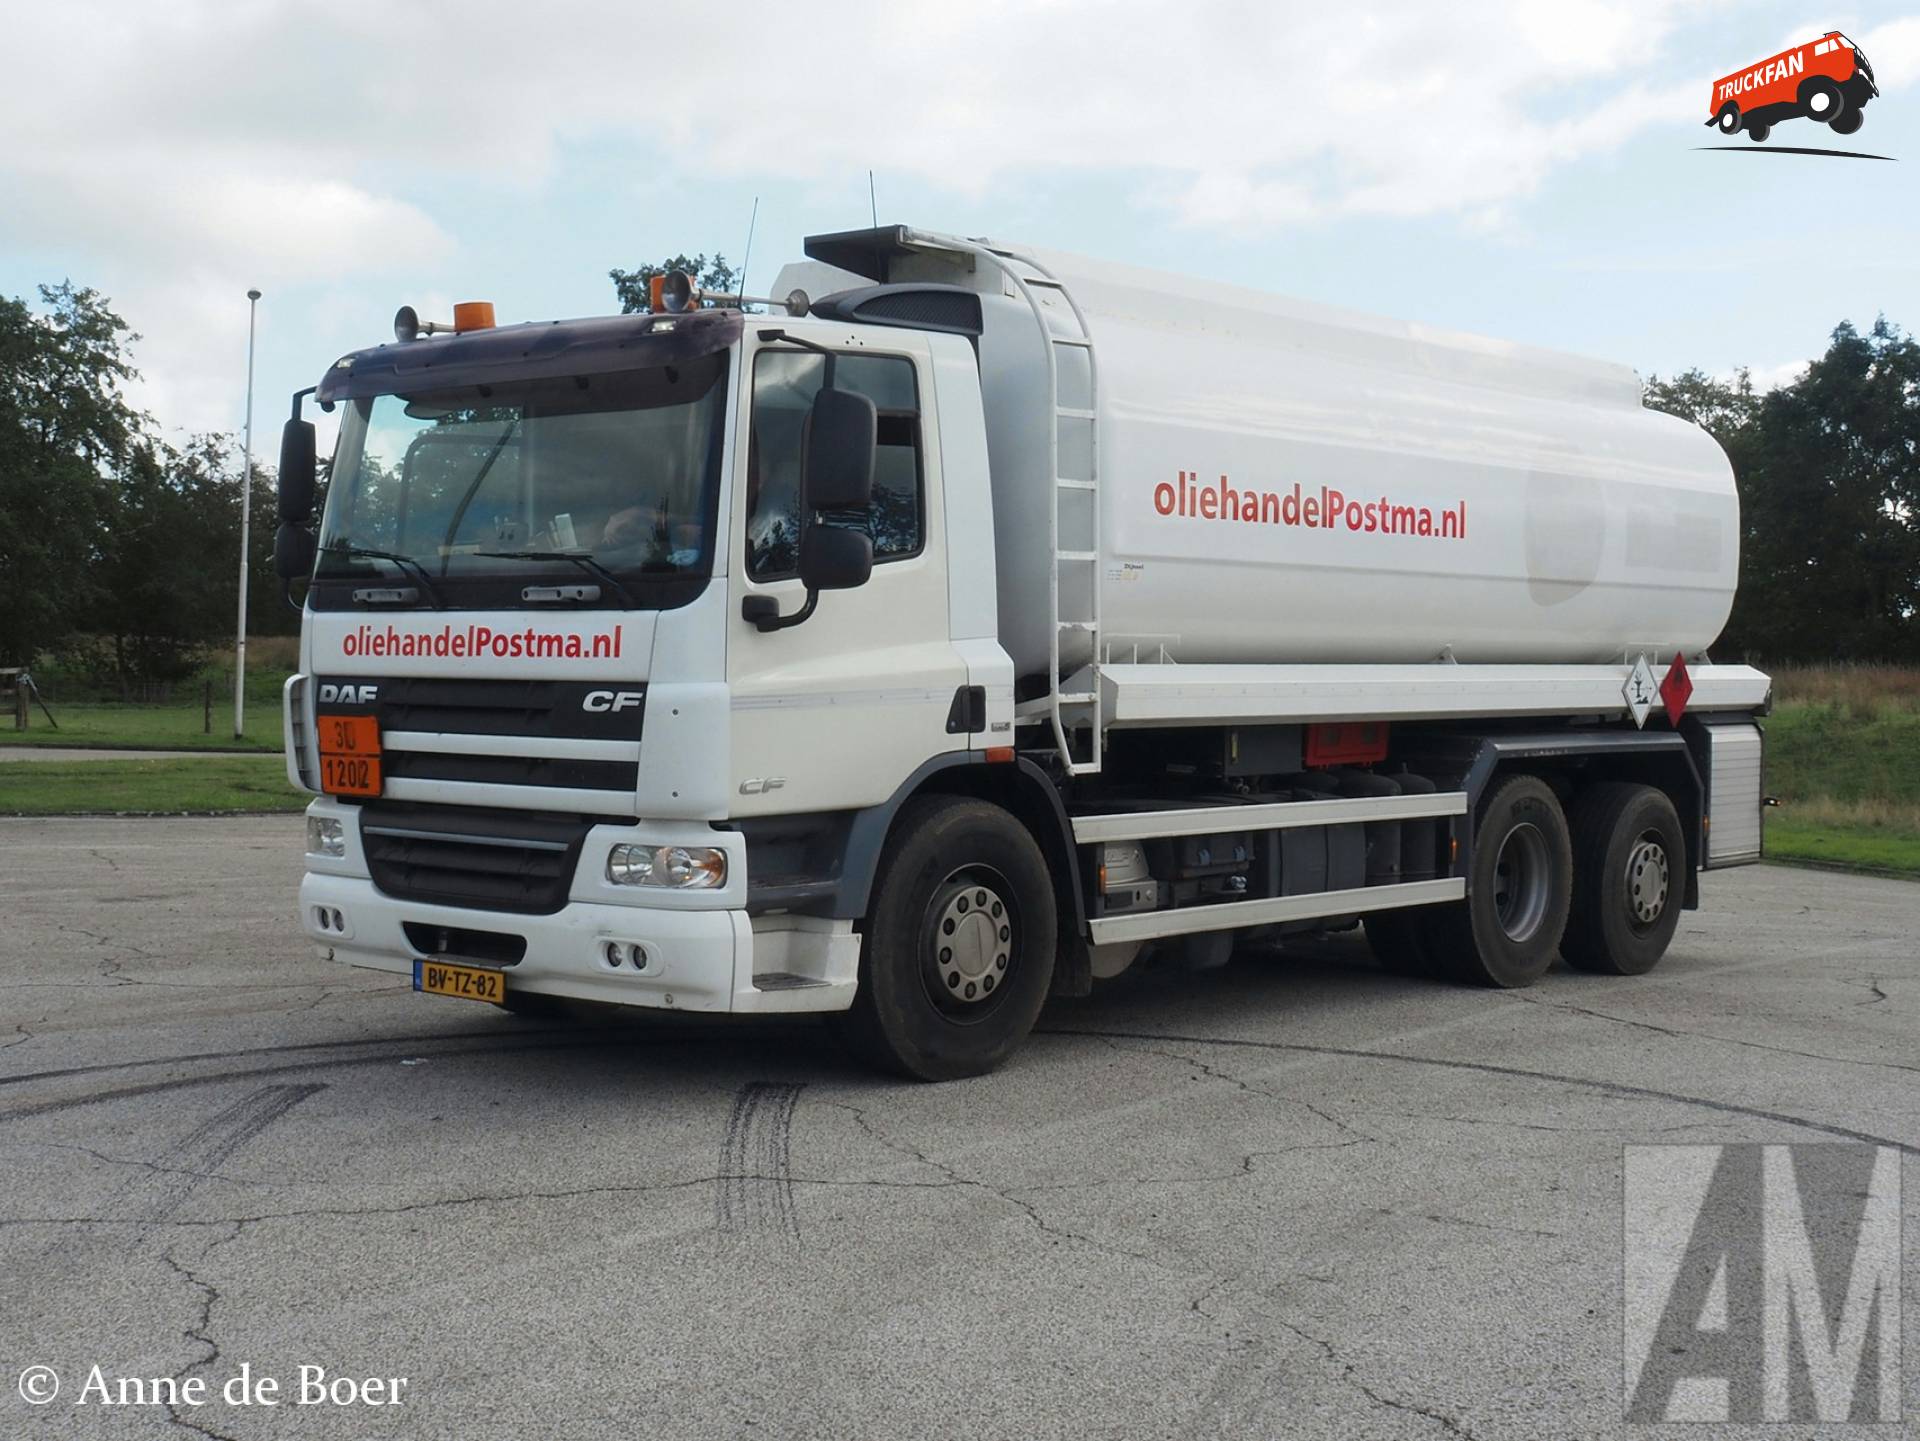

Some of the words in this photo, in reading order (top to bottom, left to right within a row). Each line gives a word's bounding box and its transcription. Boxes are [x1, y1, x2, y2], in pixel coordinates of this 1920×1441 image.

[1153, 471, 1465, 539] oliehandelPostma.nl
[343, 625, 622, 658] oliehandelPostma.nl
[319, 684, 378, 704] DAF
[582, 690, 643, 713] CF
[327, 759, 369, 789] 1202
[739, 777, 786, 795] CF
[428, 967, 497, 997] BV-TZ-82
